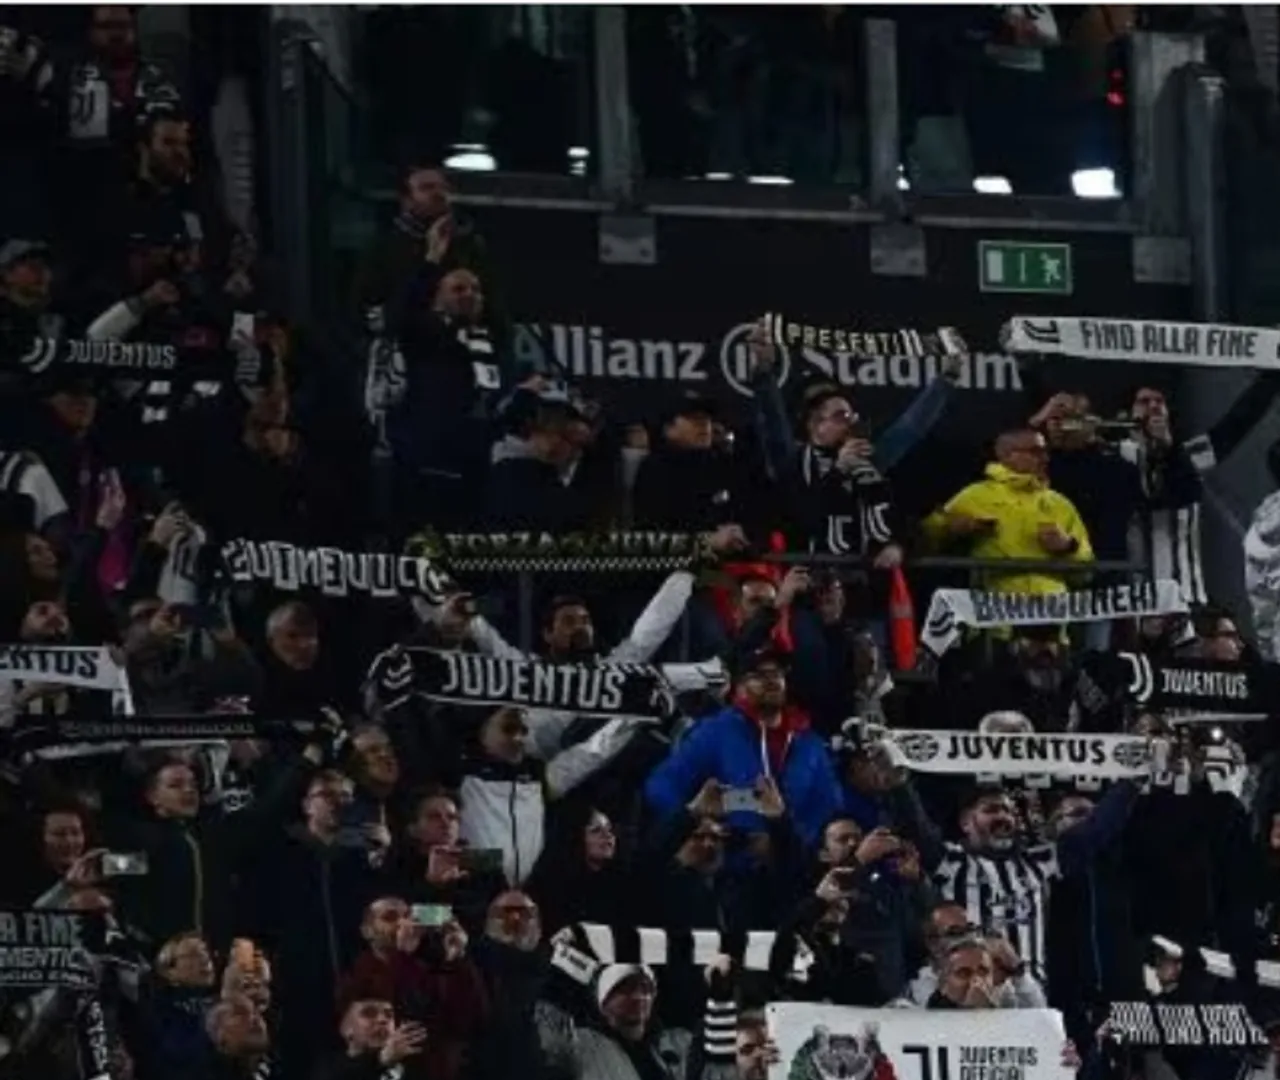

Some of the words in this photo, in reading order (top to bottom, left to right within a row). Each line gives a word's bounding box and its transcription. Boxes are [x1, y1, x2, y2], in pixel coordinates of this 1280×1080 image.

[66, 340, 176, 369] JUVENTUS
[513, 322, 708, 379] Allianz
[1080, 324, 1138, 351] FINO
[1142, 326, 1201, 354] ALLA
[1206, 330, 1257, 358] FINE
[443, 653, 624, 709] JUVENTUS
[1161, 668, 1248, 699] JUVENTUS
[947, 735, 1106, 765] JUVENTUS
